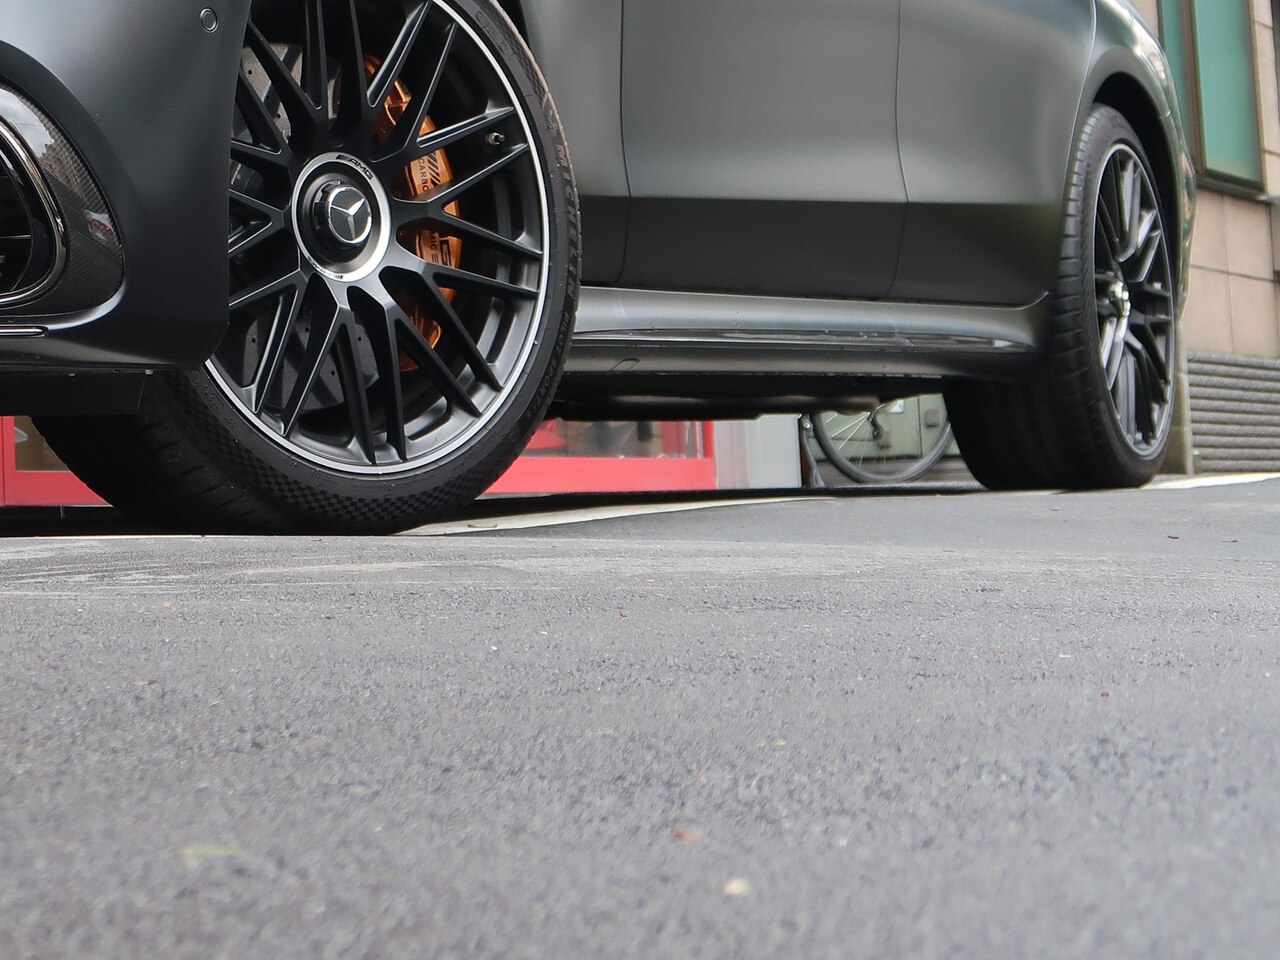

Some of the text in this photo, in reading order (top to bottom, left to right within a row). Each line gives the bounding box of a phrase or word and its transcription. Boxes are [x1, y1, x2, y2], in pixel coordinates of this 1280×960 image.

[349, 159, 374, 180] AMG
[417, 158, 430, 192] CARBO
[556, 143, 578, 300] MICHELIN
